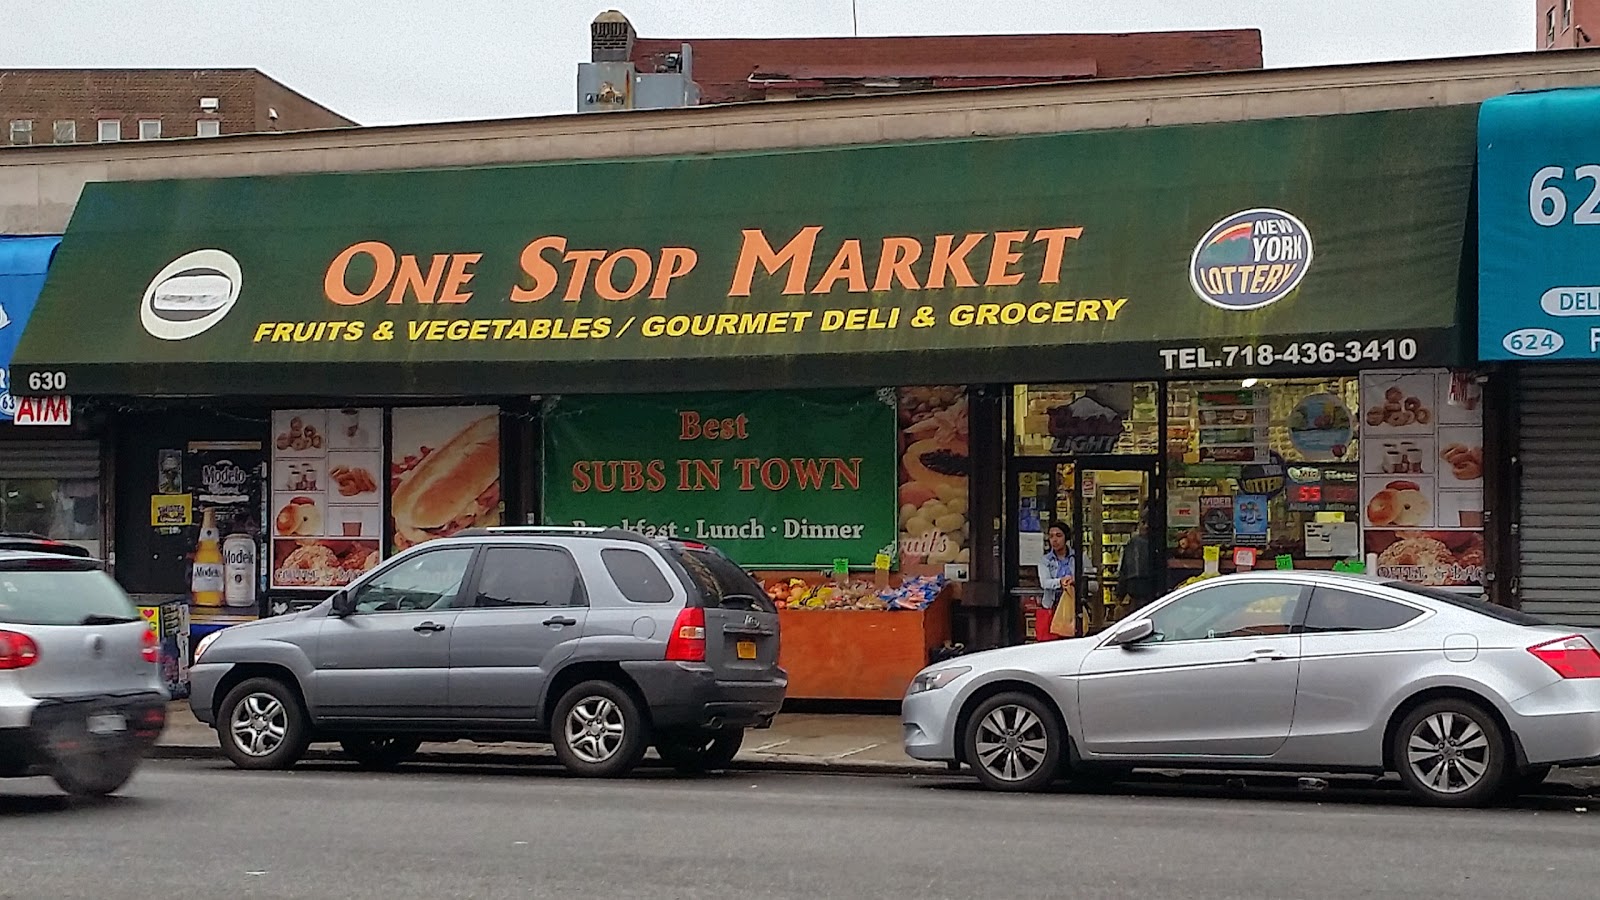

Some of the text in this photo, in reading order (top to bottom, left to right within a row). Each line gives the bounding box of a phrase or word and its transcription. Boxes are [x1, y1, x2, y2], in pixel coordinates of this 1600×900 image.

[1253, 219, 1293, 236] NEW
[1251, 234, 1302, 263] YORK
[323, 225, 1084, 306] ONE STOP MARKET
[1200, 262, 1297, 297] LOTTERY
[253, 297, 1129, 344] FRUITS & VEGETABLES / GOURMET DELI & GROCERY
[1159, 337, 1418, 371] TEL.718-436-3410
[1510, 334, 1554, 350] 624
[28, 371, 67, 391] 630
[17, 396, 68, 422] ATM
[679, 411, 749, 441] Best
[202, 464, 247, 486] Modelo
[571, 457, 862, 493] SUBS IN TOWN
[696, 520, 765, 539] Lunch
[783, 519, 865, 539] Dinner
